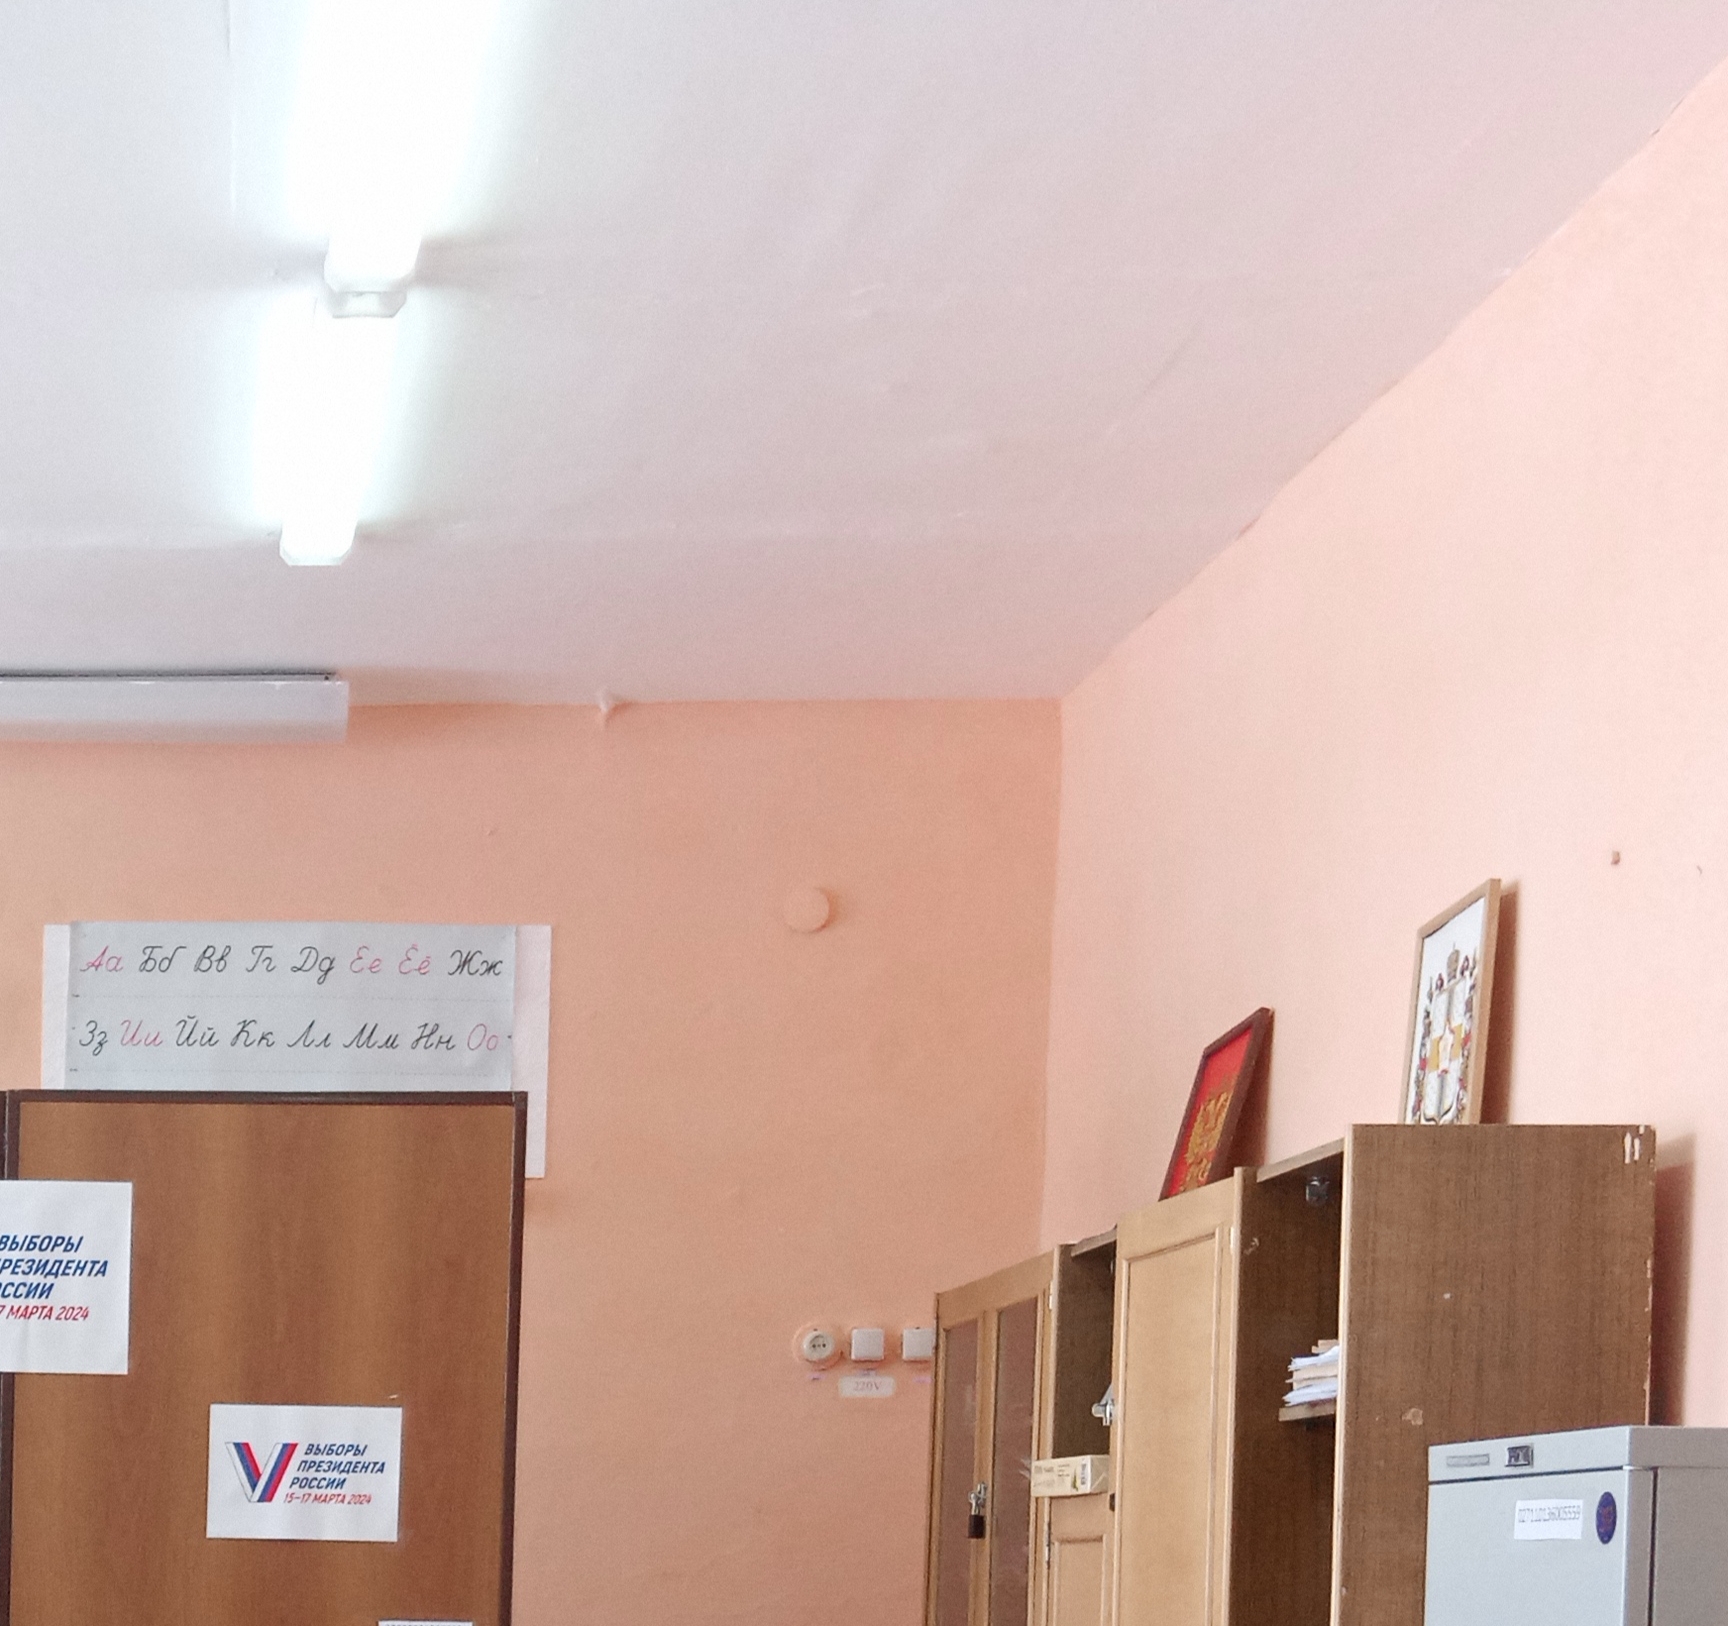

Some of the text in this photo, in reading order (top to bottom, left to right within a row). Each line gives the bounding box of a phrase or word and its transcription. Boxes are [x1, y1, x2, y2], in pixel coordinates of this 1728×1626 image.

[80, 945, 124, 974] Аа
[138, 945, 186, 974] Бб
[194, 945, 230, 973] Вв
[245, 945, 277, 973] Гг
[349, 945, 383, 974] Ее
[398, 942, 432, 975] Ёё
[447, 949, 502, 978] Жж
[78, 1015, 499, 1057] Зз Ии Йй Кк Лл Мм Нн Оо
[6, 1305, 52, 1320] МАРТА
[55, 1306, 90, 1321] 2024
[854, 1382, 881, 1390] 220V
[304, 1444, 368, 1456] ВЫБОРЫ
[297, 1460, 385, 1474] ПРЕЗИДЕНТА
[289, 1477, 347, 1489] РОССИИ
[313, 1494, 346, 1504] МАРТА
[347, 1494, 372, 1505] 2024
